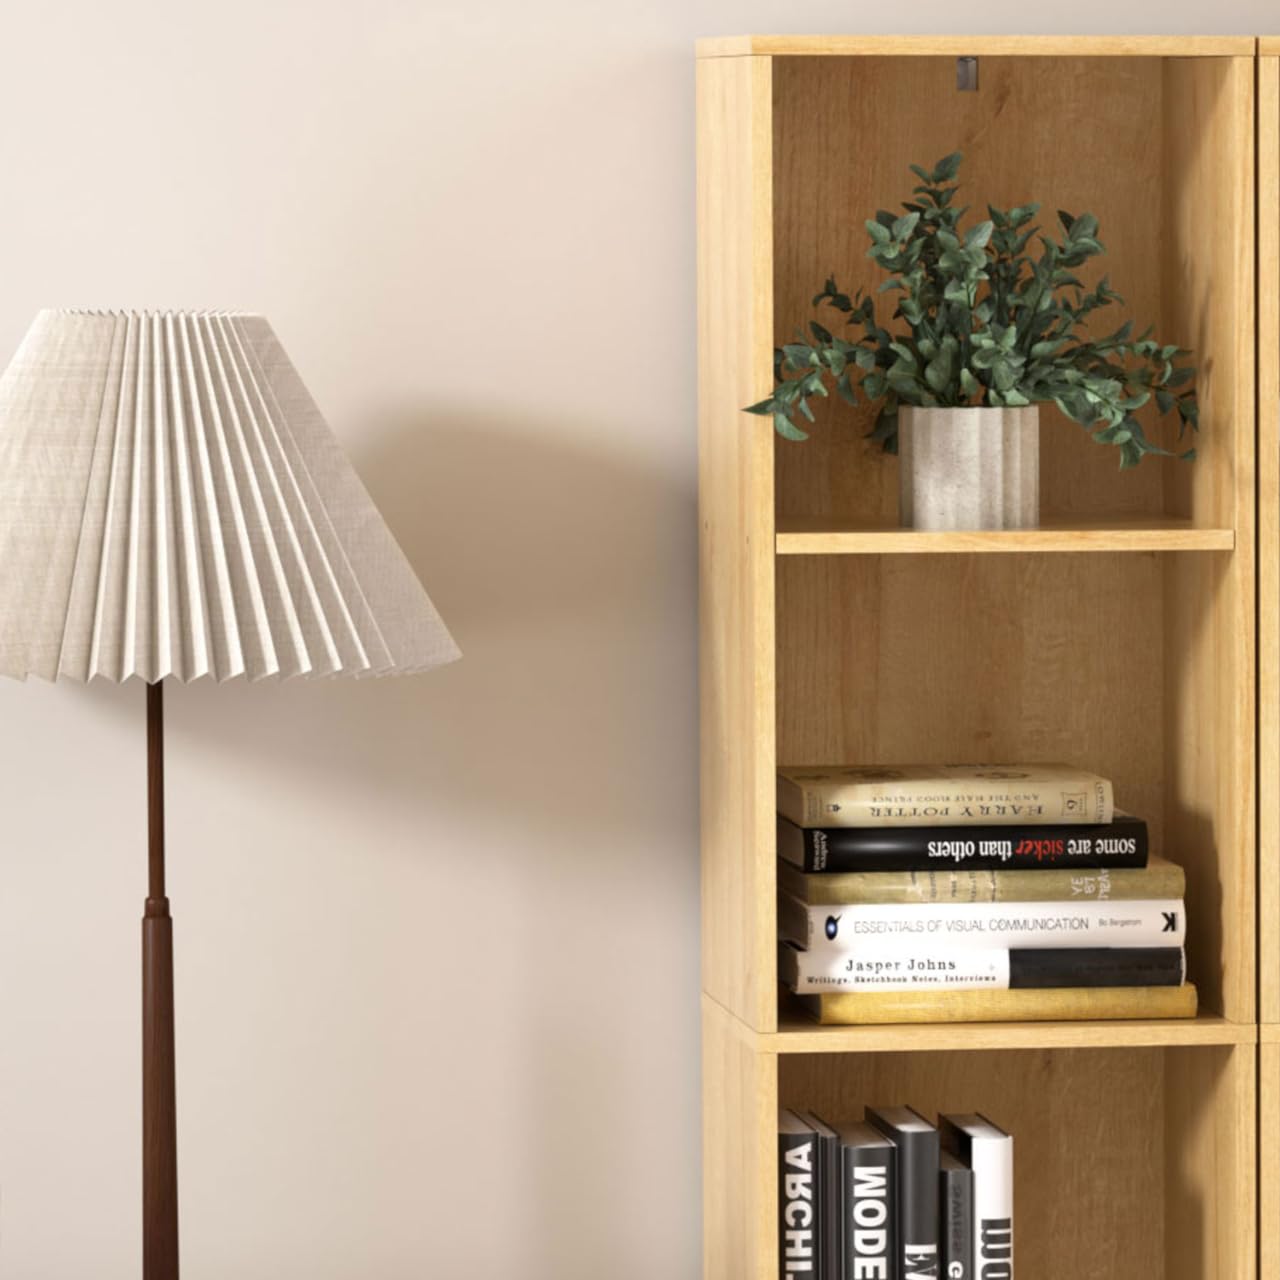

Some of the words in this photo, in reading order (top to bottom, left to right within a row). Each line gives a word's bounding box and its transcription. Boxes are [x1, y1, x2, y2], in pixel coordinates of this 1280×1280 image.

[869, 806, 950, 818] POTTER
[960, 804, 1042, 817] HARRY
[927, 840, 975, 862] others
[979, 840, 1013, 862] than
[1015, 838, 1064, 862] sicker
[1067, 839, 1091, 855] are
[1095, 838, 1136, 854] some
[853, 919, 925, 934] ESSENTIALS
[927, 919, 942, 933] OF
[945, 919, 985, 933] VISUAL
[988, 917, 1090, 932] COMMUNICATION
[1160, 911, 1177, 932] K
[845, 959, 901, 975] Jasper
[907, 958, 957, 971] Johns
